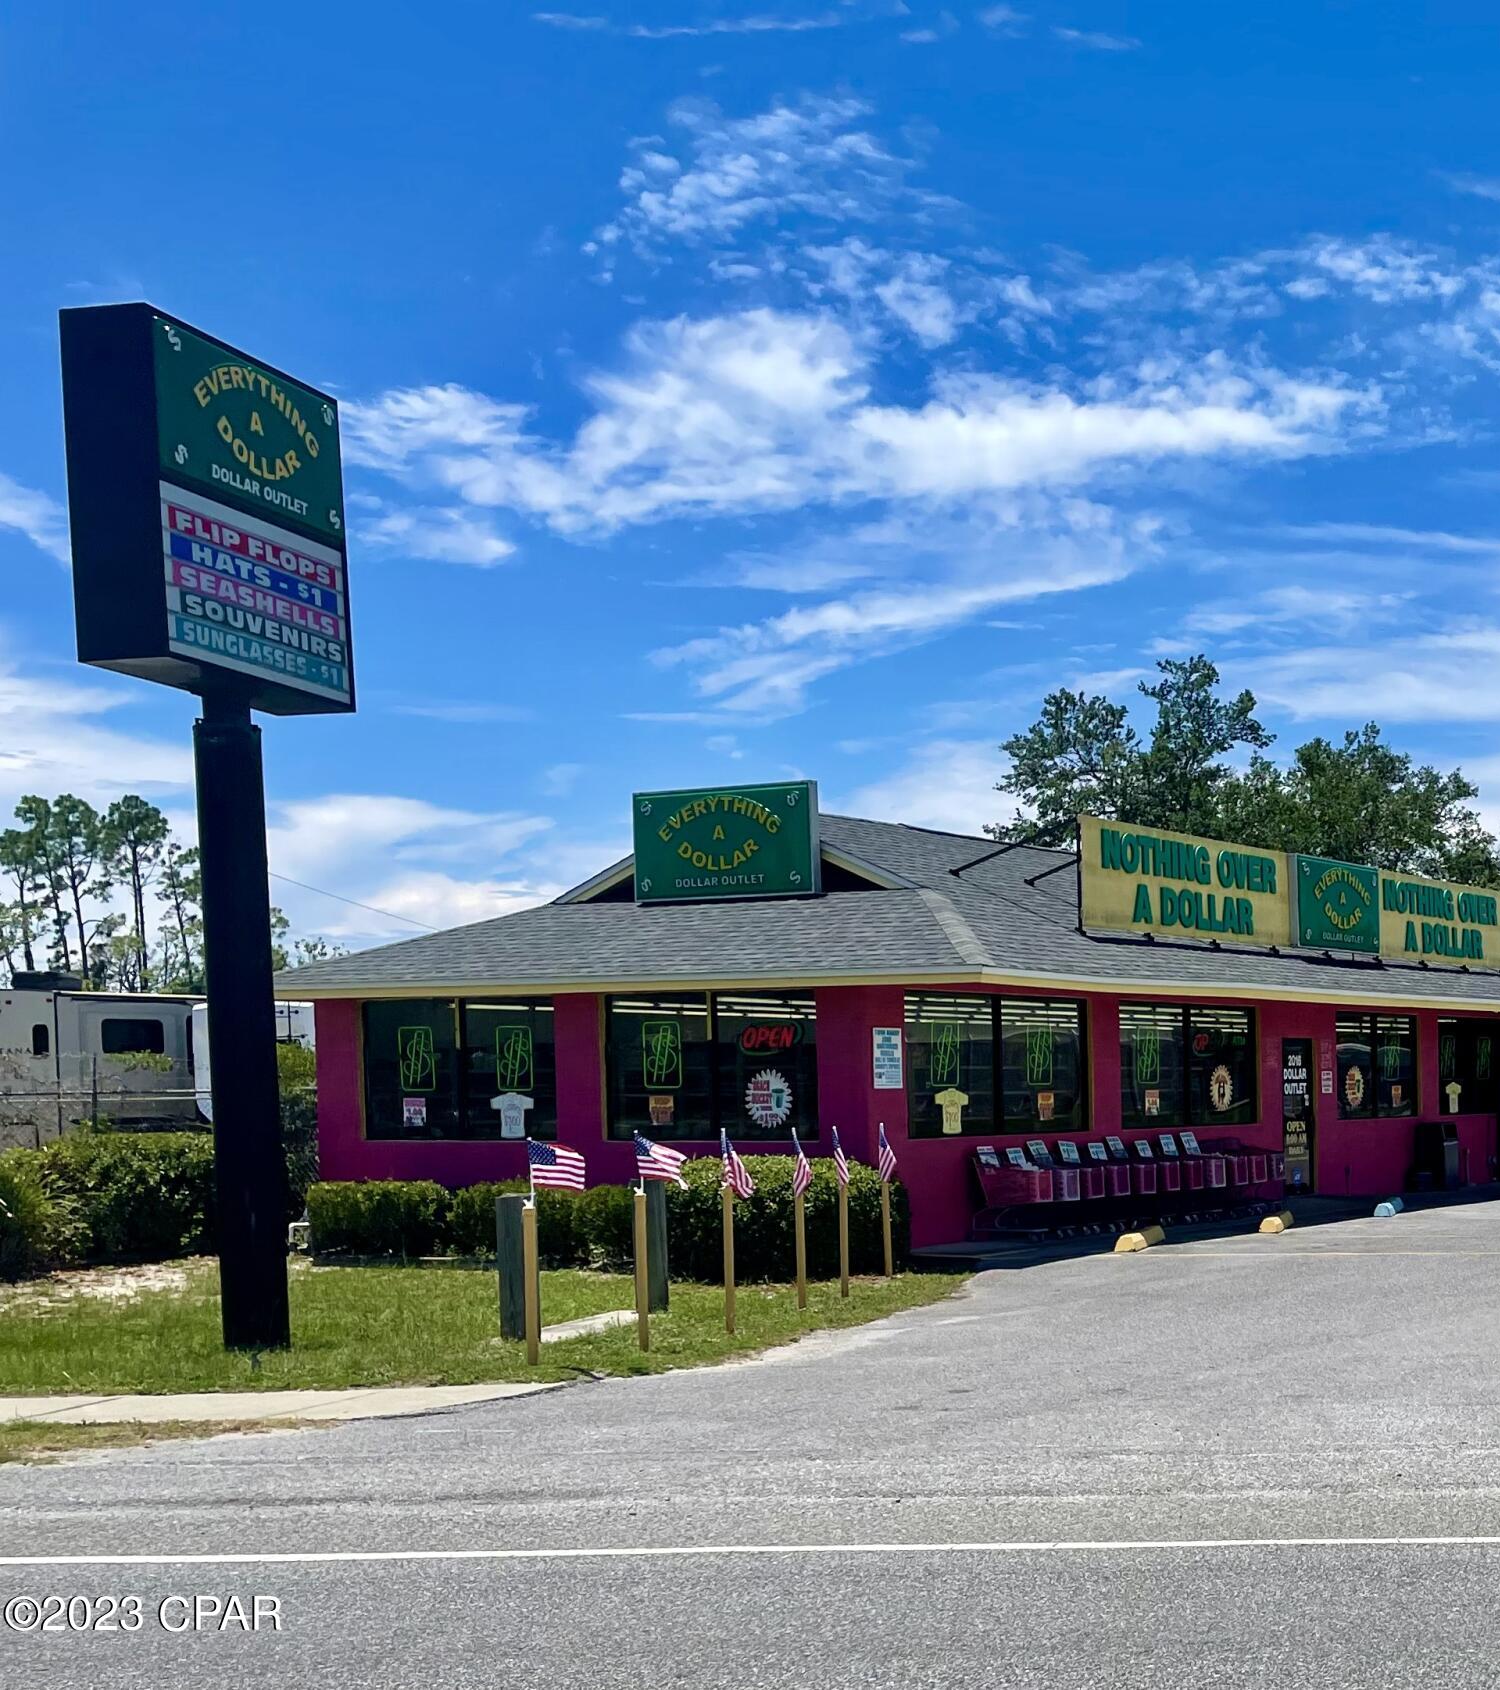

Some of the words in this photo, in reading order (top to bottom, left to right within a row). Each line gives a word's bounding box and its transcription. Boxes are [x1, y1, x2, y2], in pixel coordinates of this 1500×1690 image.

[193, 366, 320, 459] EVERYTHING
[250, 411, 265, 437] A
[216, 415, 302, 481] DOLLAR
[211, 463, 261, 497] DOLLAR
[263, 486, 309, 516] OUTLET
[174, 509, 241, 548] FLIP
[247, 536, 331, 586] FLOPS
[191, 541, 272, 588] HATS
[297, 582, 322, 608] $1
[178, 565, 335, 637] SEASHELLS
[185, 594, 343, 663] SOUVENIRS
[183, 620, 307, 676] SUNGLASSES
[320, 665, 339, 686] $1
[657, 795, 783, 843] EVERYTHING
[712, 824, 725, 841] A
[676, 838, 760, 872] DOLLAR
[1100, 827, 1212, 885] NOTHING
[1216, 849, 1277, 895] OVER
[675, 876, 719, 889] DOLLAR
[721, 874, 765, 886] OUTLET
[1313, 866, 1373, 907] EVERYTHING
[1339, 891, 1347, 905] A
[1381, 877, 1455, 921] NOTHING
[1457, 891, 1499, 926] OVER
[1132, 883, 1154, 925] A
[1159, 886, 1255, 936] DOLLAR
[1323, 901, 1363, 930] DOLLAR
[1322, 931, 1343, 942] DOLLAR
[1404, 920, 1419, 953] A
[1420, 921, 1484, 960] DOLLAR
[742, 1025, 796, 1049] OPEN
[1283, 1067, 1307, 1080] DOLLAR
[1284, 1082, 1307, 1095] OUTLET
[1286, 1120, 1306, 1132] OPEN
